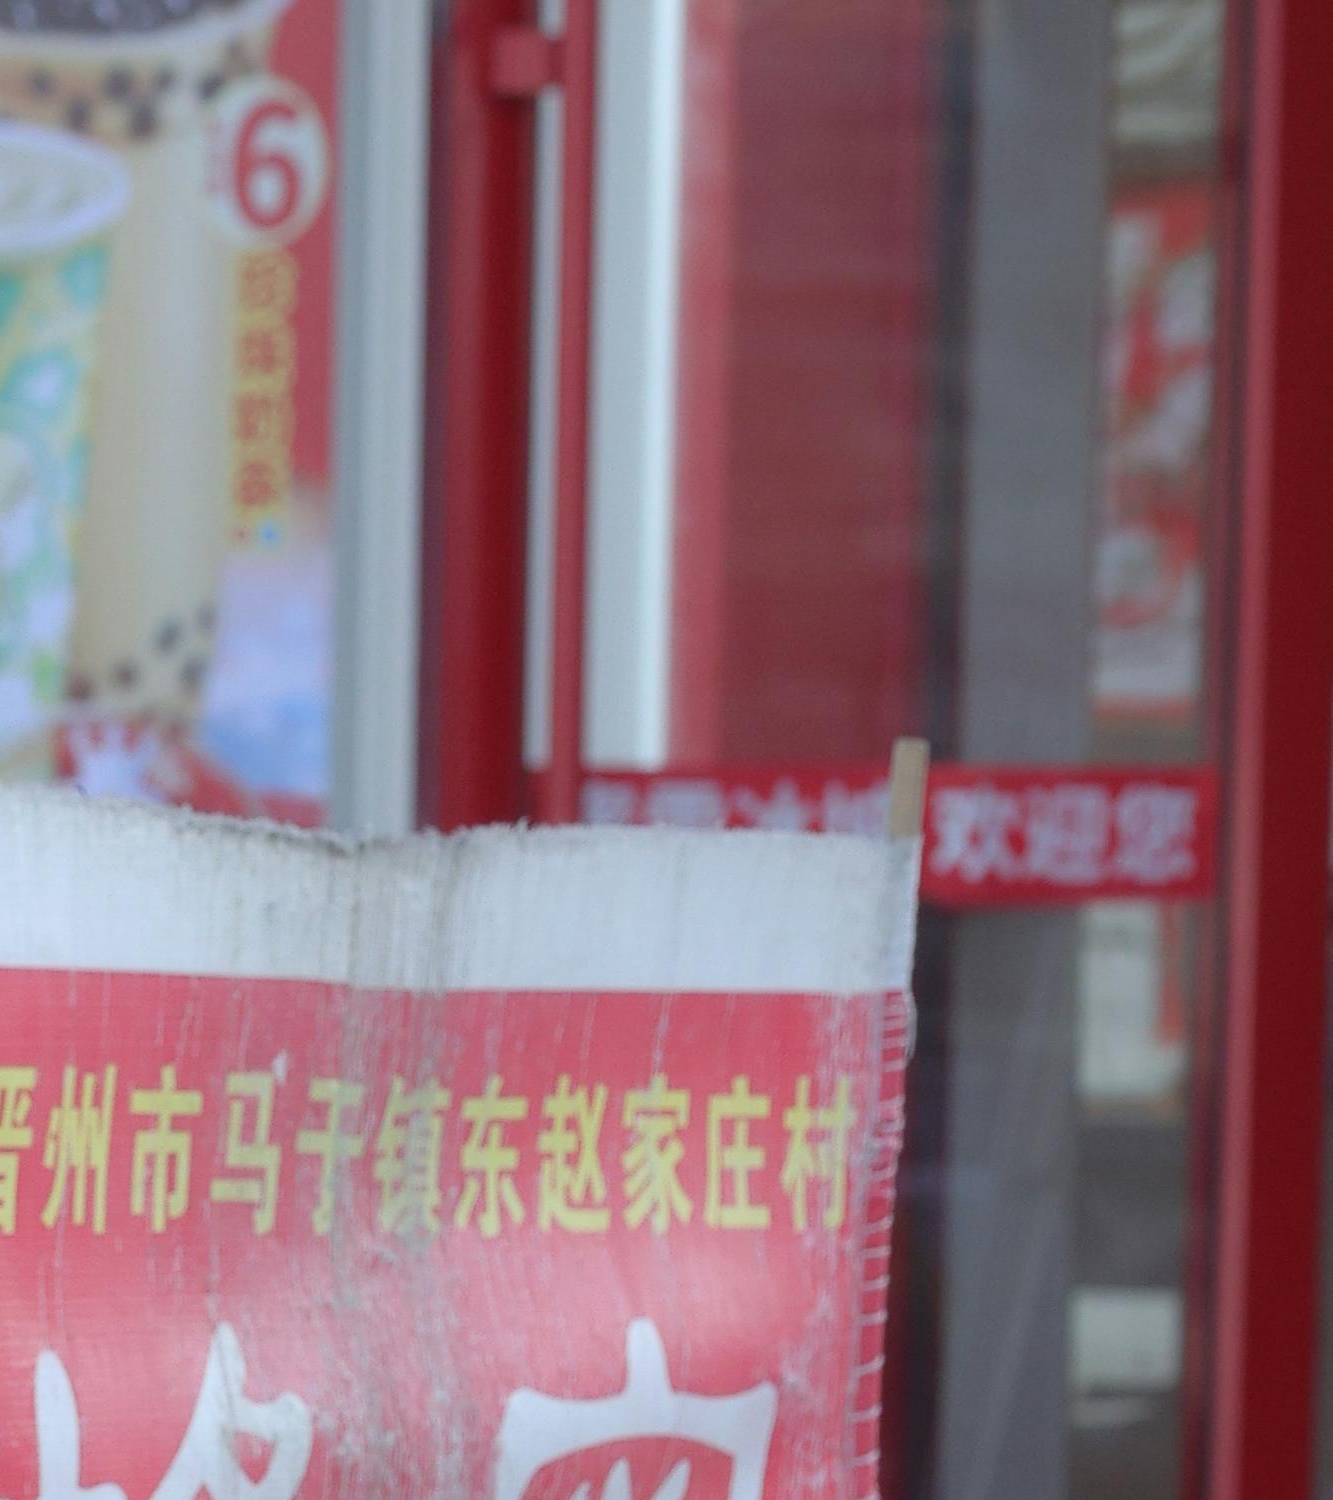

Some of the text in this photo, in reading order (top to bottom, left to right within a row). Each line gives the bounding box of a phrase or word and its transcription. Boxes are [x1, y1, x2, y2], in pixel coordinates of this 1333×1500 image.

[236, 101, 299, 228] 6
[933, 785, 1198, 884] 欢迎您
